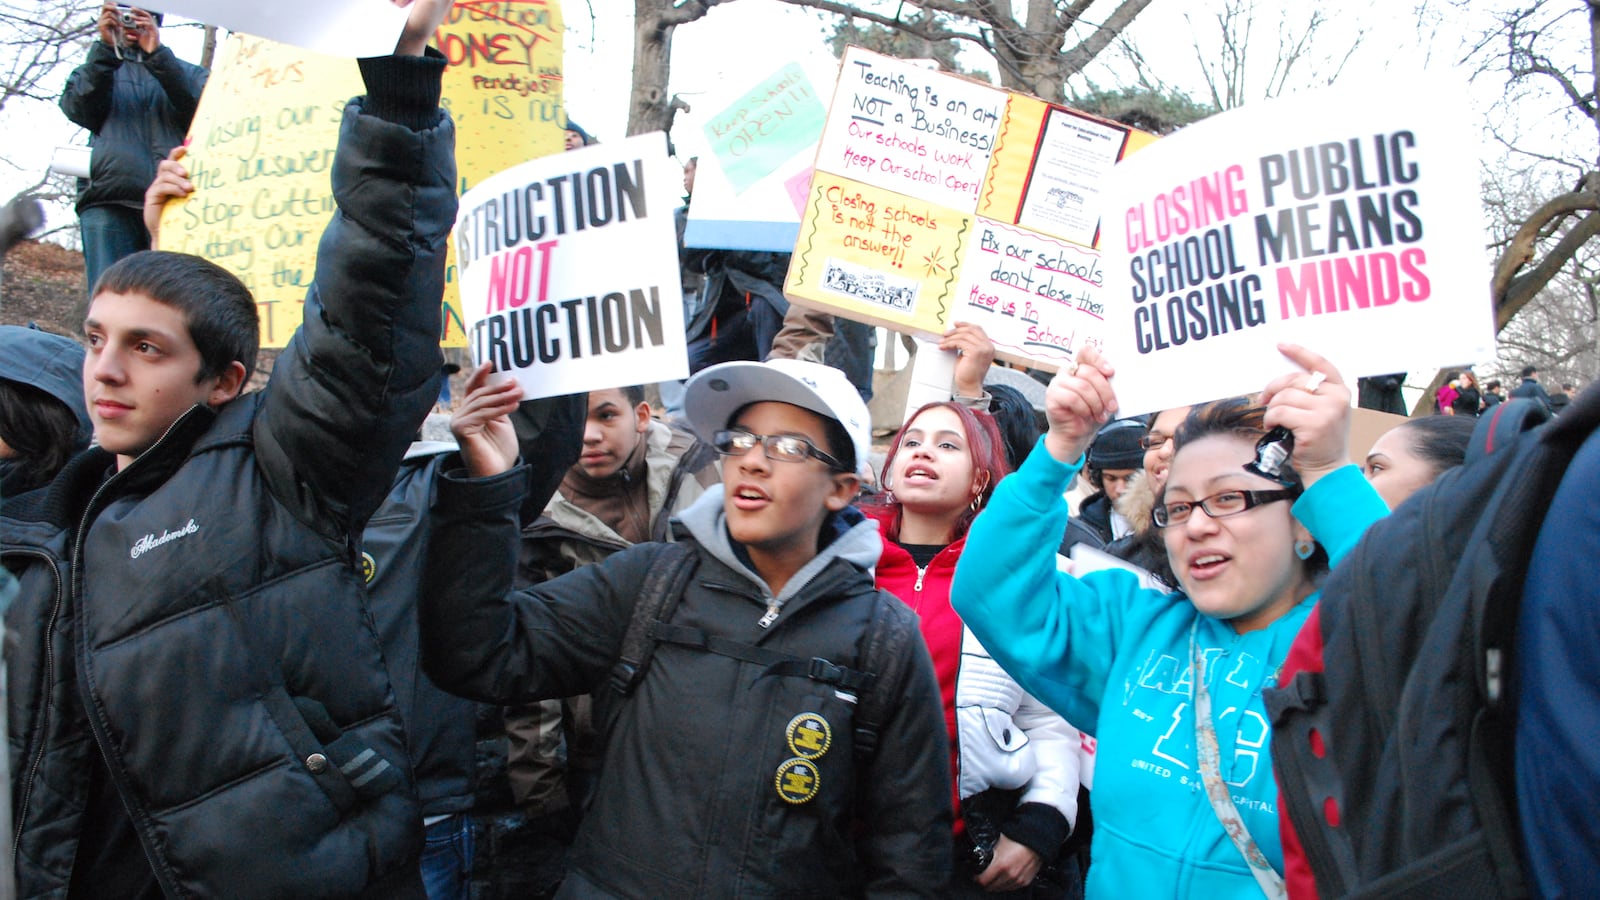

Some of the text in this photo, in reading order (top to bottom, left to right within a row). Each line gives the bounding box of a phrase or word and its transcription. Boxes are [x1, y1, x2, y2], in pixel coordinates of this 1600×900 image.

[853, 60, 998, 128] Teaching is an art
[204, 114, 262, 161] losing
[848, 121, 873, 139] Our
[876, 131, 927, 156] schools
[853, 93, 995, 158] NOT a Business!
[188, 156, 226, 190] the
[843, 145, 876, 172] Keep
[880, 158, 902, 174] Our
[903, 164, 942, 185] school
[184, 188, 334, 231] Stop Cuttin
[826, 185, 876, 222] Closing
[883, 205, 937, 229] schools
[1125, 129, 1420, 254] CLOSING PUBLIC
[832, 204, 912, 247] is not the
[1130, 189, 1423, 304] SCHOOL MEANS
[843, 234, 906, 269] answer!!
[981, 229, 1104, 285] Fix our schools
[486, 239, 559, 315] NOT
[1037, 275, 1072, 304] close
[969, 283, 1039, 321] Keep us in
[1134, 247, 1431, 355] CLOSING MINDS
[469, 285, 665, 374] TRUCTION
